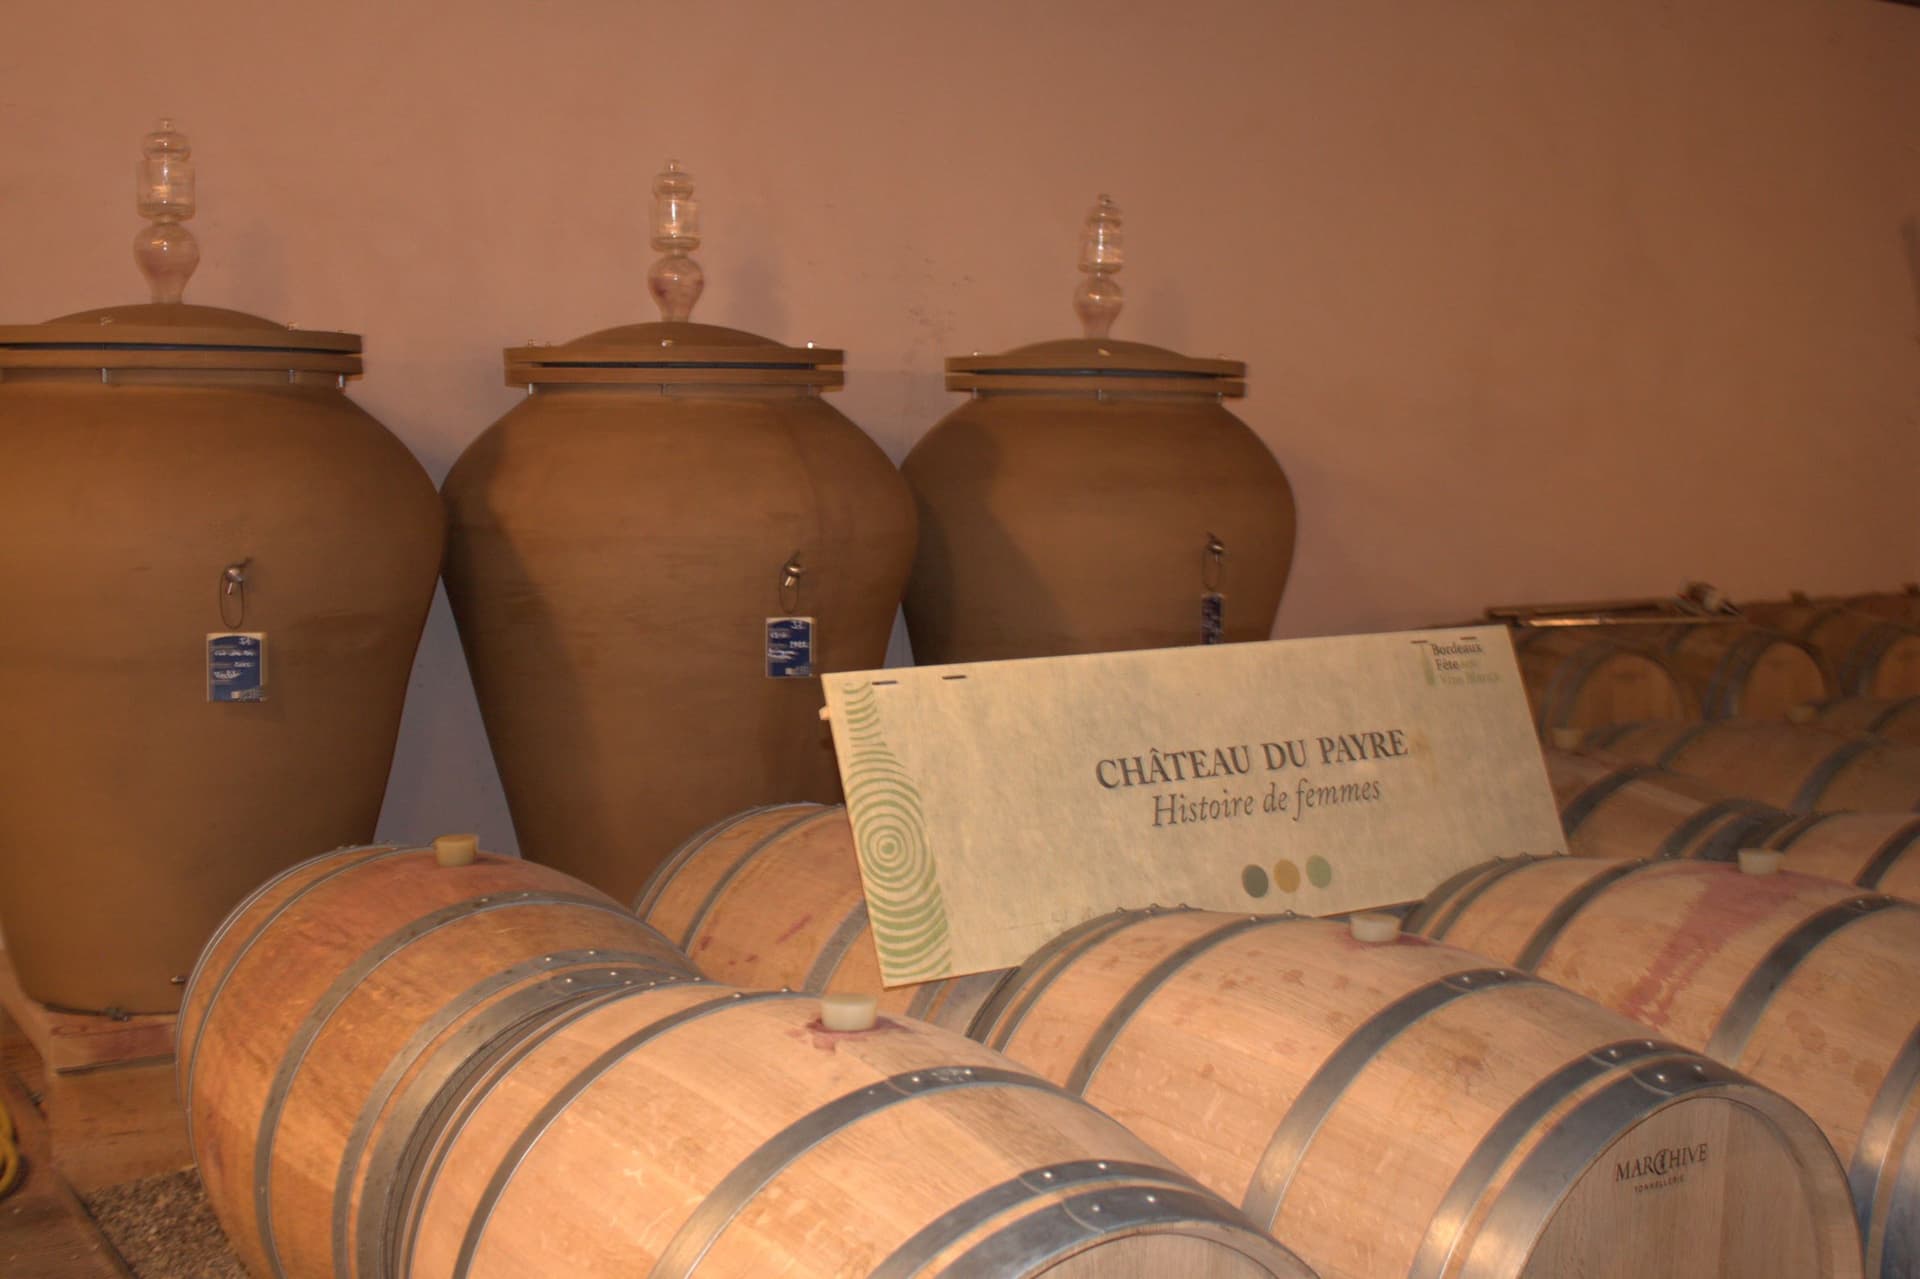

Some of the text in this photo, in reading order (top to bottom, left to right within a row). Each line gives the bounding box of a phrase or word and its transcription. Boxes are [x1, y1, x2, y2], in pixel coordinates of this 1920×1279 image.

[1431, 642, 1483, 656] Bordeaux
[1095, 729, 1409, 790] CHÂTEAU DU PAYRE
[1151, 778, 1381, 827] Histoire de femmes
